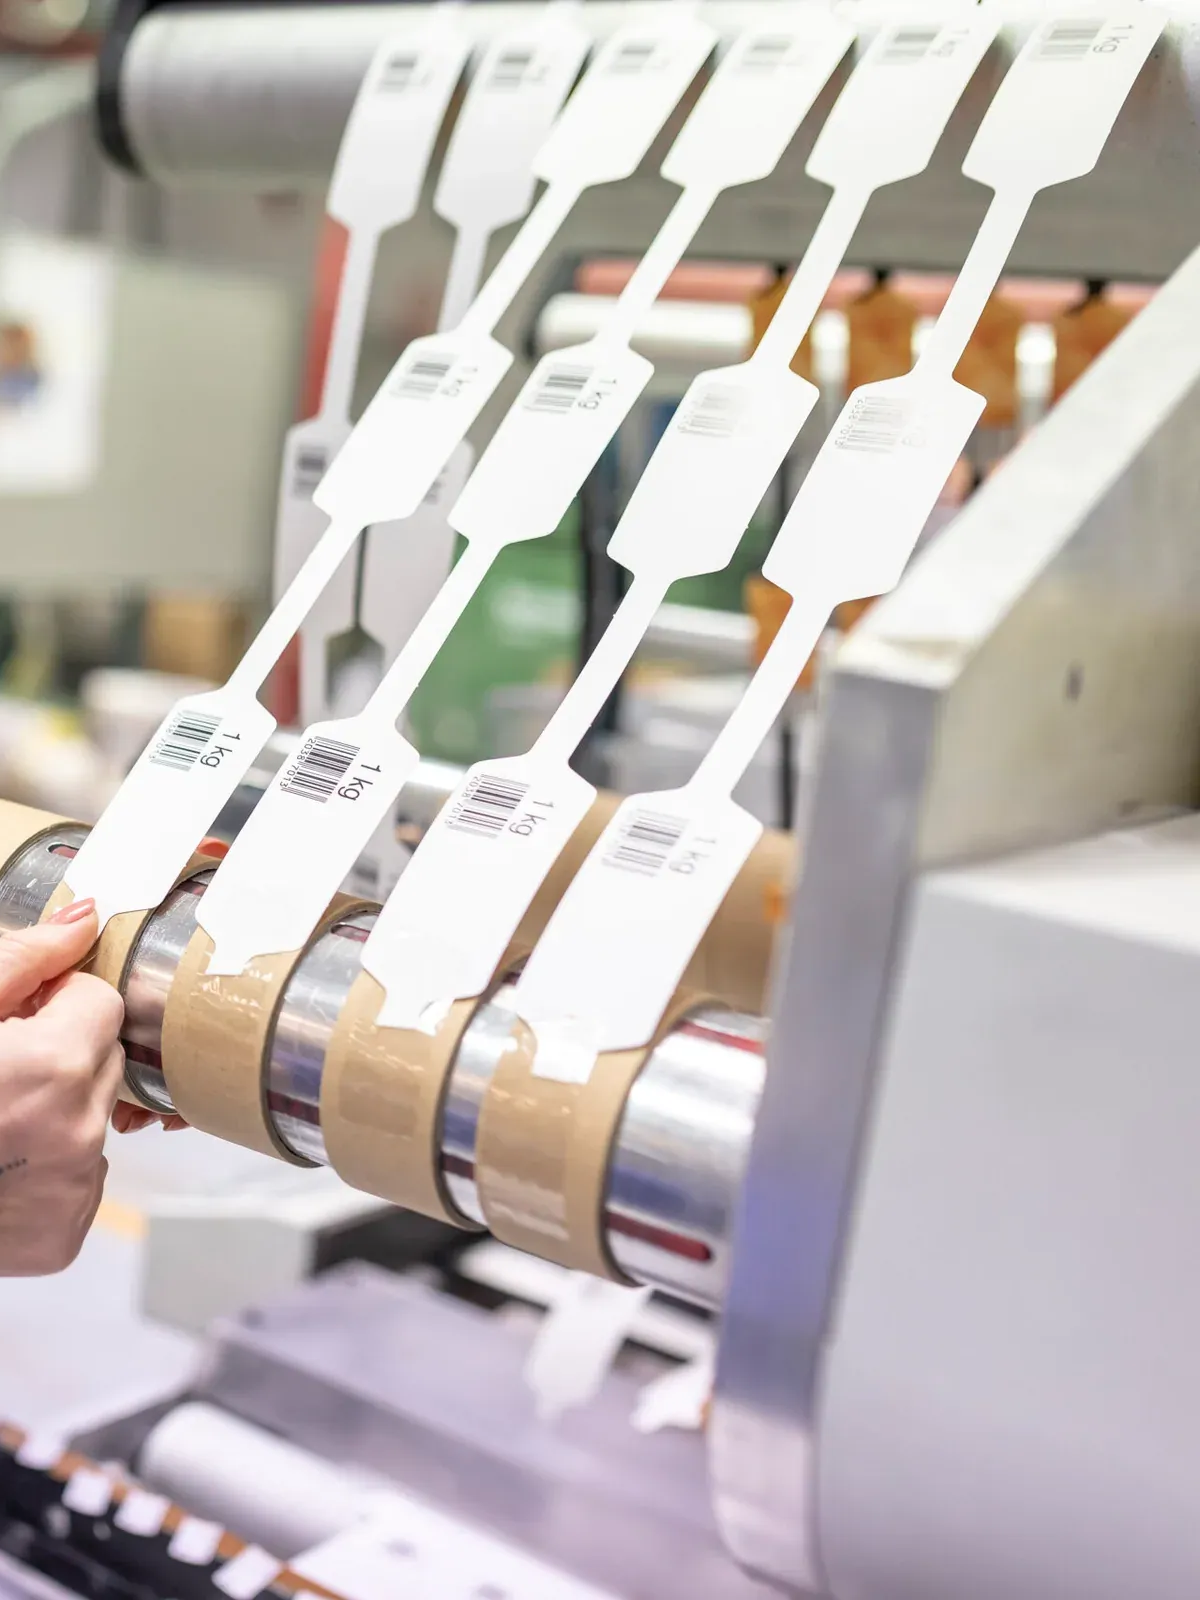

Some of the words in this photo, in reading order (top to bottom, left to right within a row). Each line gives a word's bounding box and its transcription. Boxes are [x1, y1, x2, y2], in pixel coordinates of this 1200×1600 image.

[1092, 36, 1129, 53] kg
[222, 733, 241, 741] 1
[200, 745, 233, 768] kg
[296, 738, 317, 760] 2038
[280, 764, 299, 788] 7013
[361, 764, 382, 773] 1
[337, 776, 374, 801] kg
[532, 800, 555, 808] 1
[508, 813, 547, 836] kg
